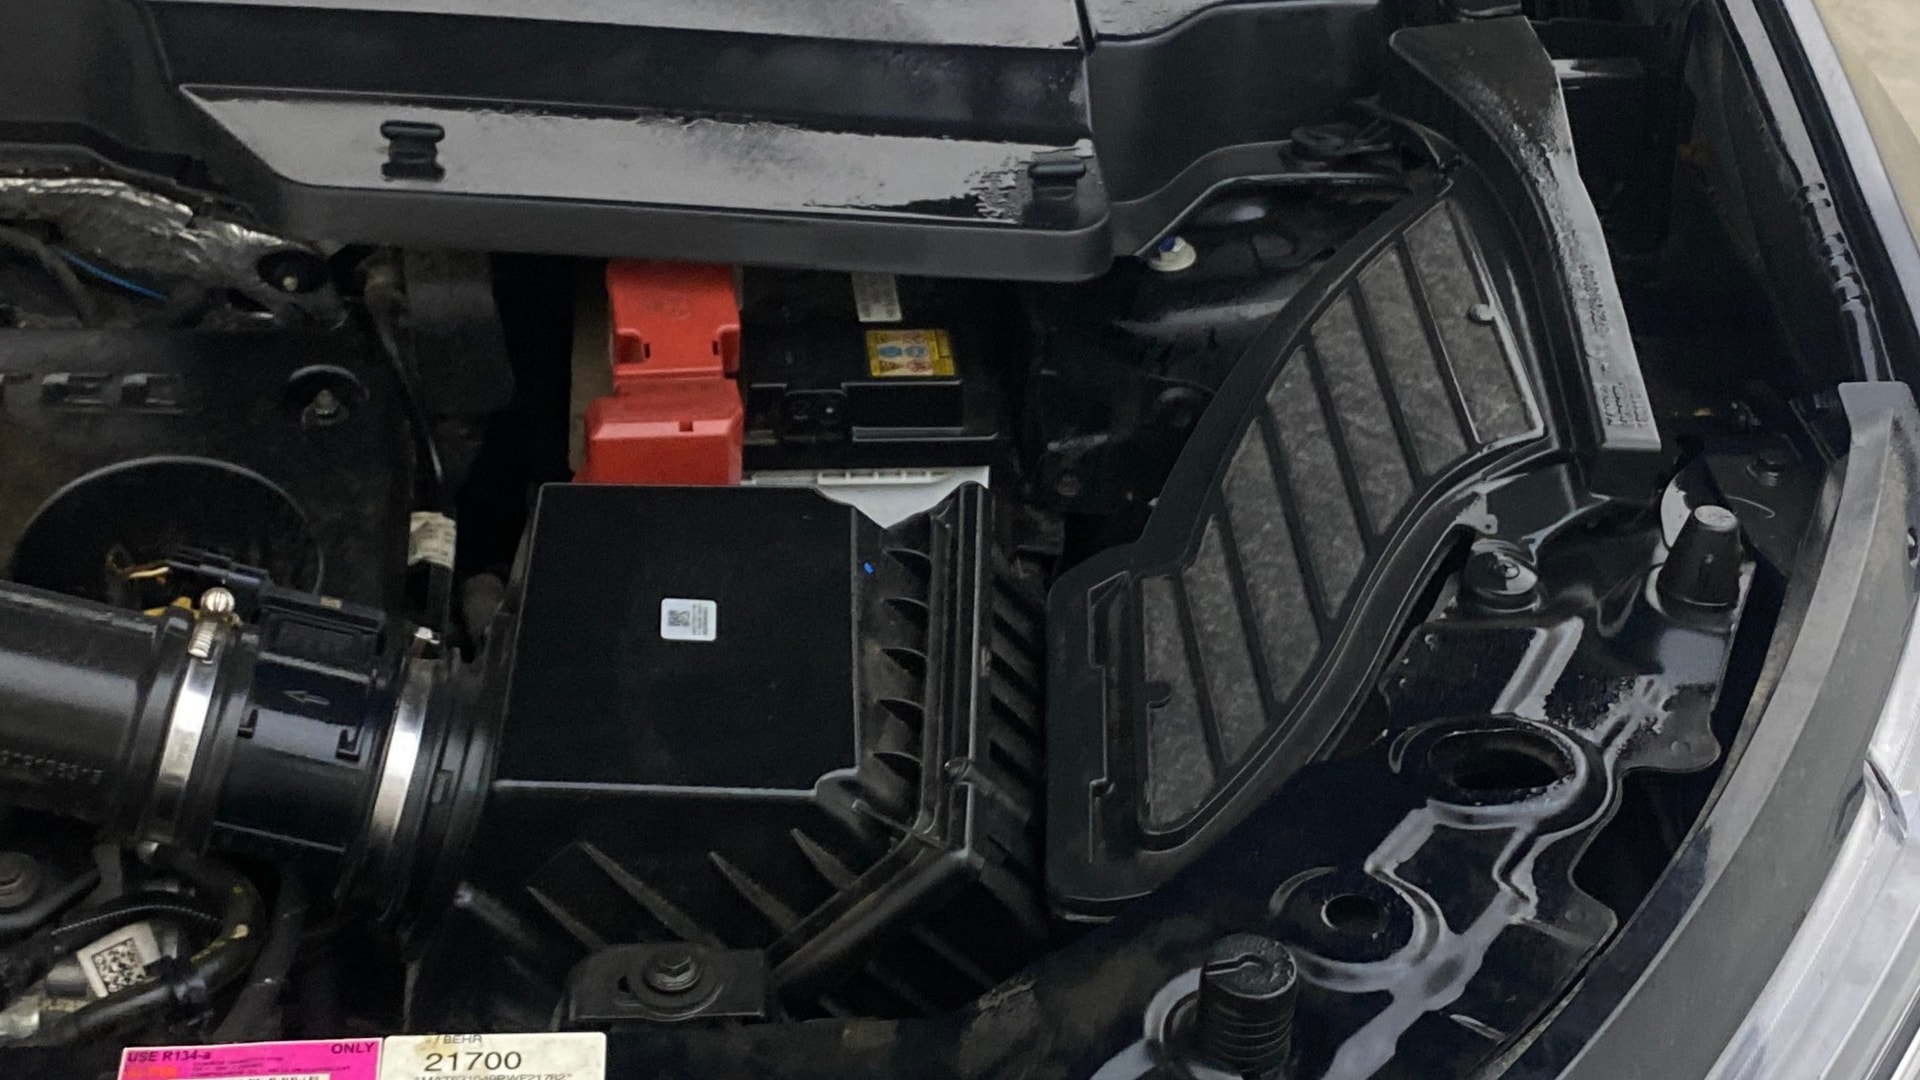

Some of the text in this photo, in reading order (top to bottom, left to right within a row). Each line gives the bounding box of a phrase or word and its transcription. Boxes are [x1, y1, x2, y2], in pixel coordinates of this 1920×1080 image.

[128, 1042, 374, 1062] USE R134-a ONLY
[424, 1051, 522, 1071] 21700
